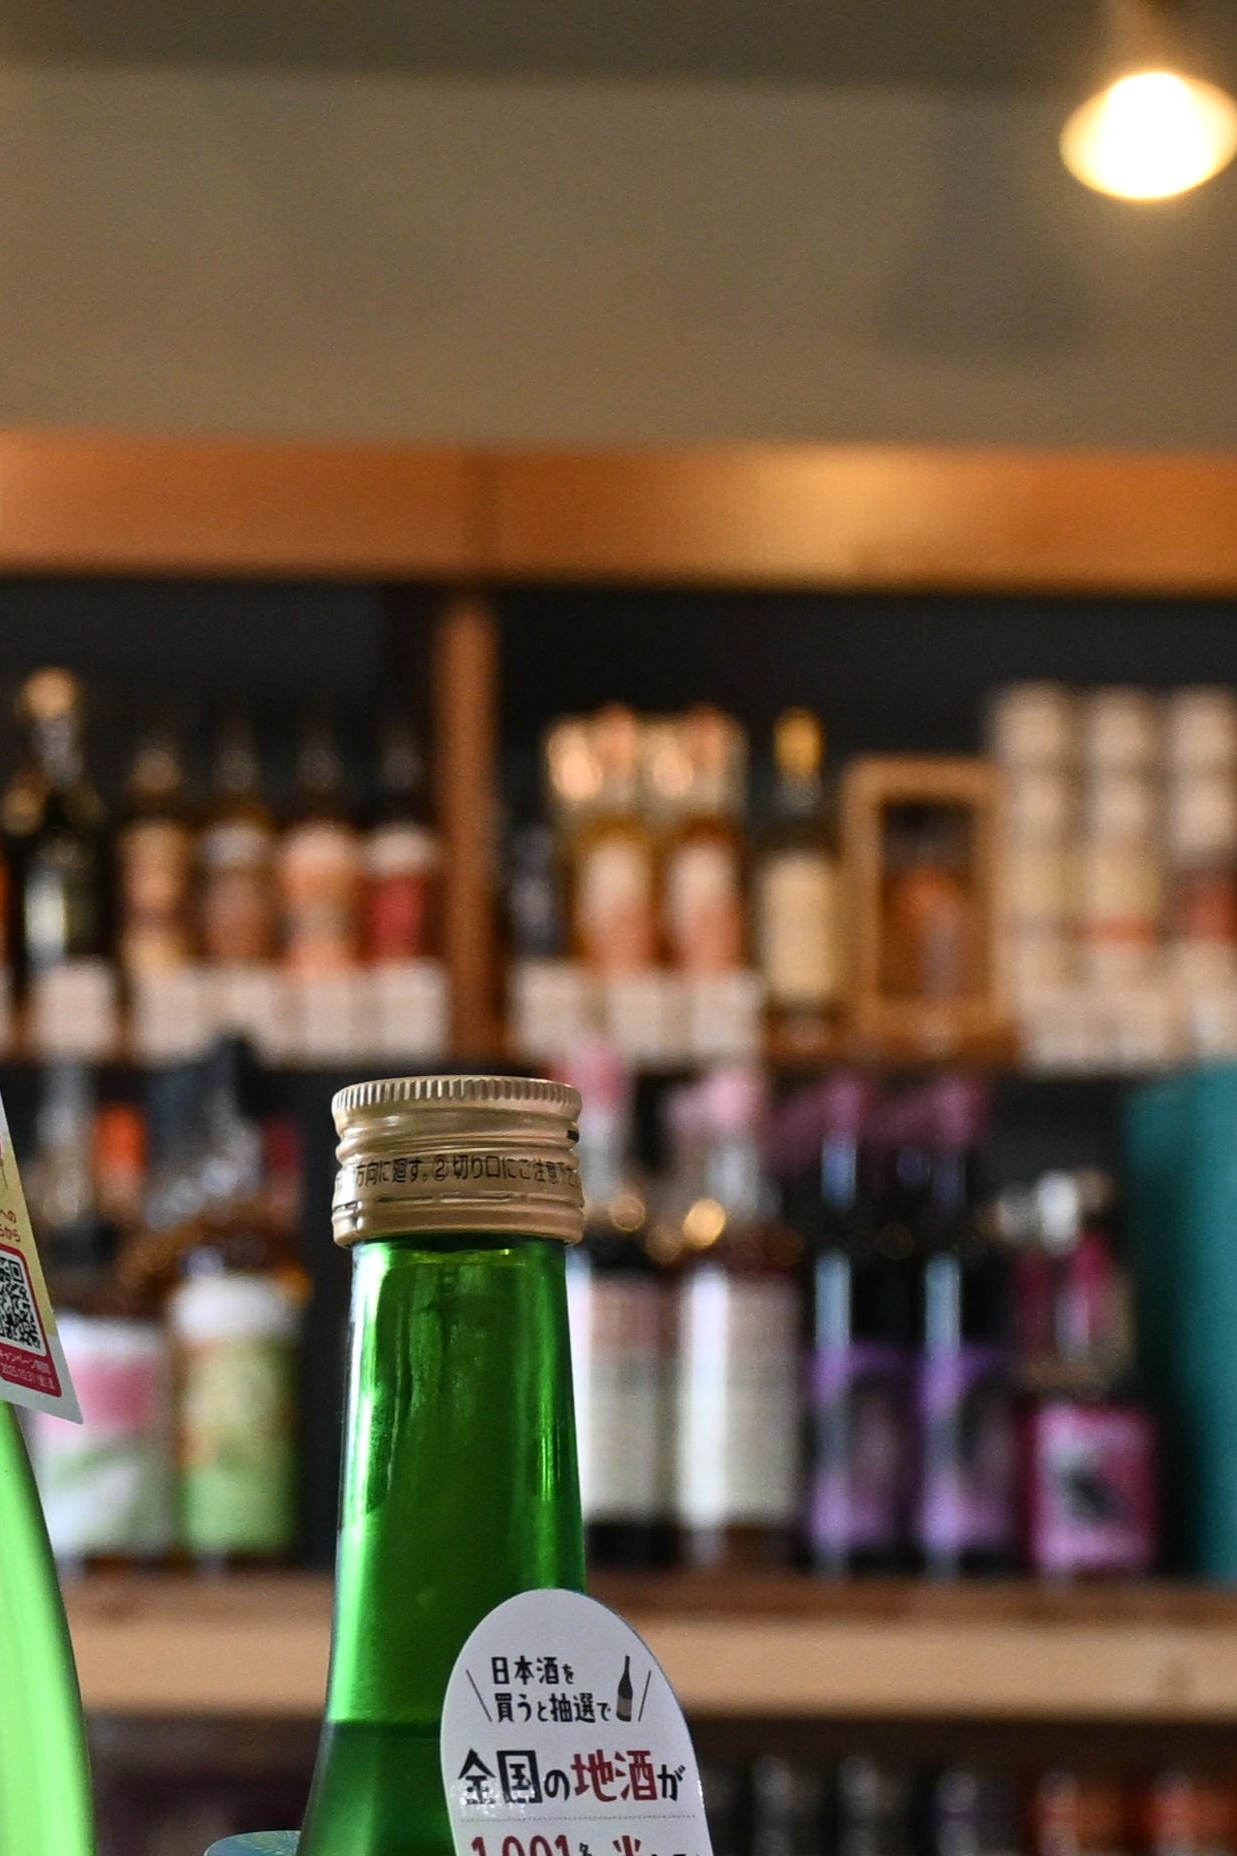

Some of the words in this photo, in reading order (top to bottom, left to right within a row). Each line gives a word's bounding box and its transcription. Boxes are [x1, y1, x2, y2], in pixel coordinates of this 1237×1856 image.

[491, 1656, 575, 1686] 日本酒を
[494, 1693, 612, 1723] 買うと抽選で
[458, 1748, 687, 1806] 全国の地酒が
